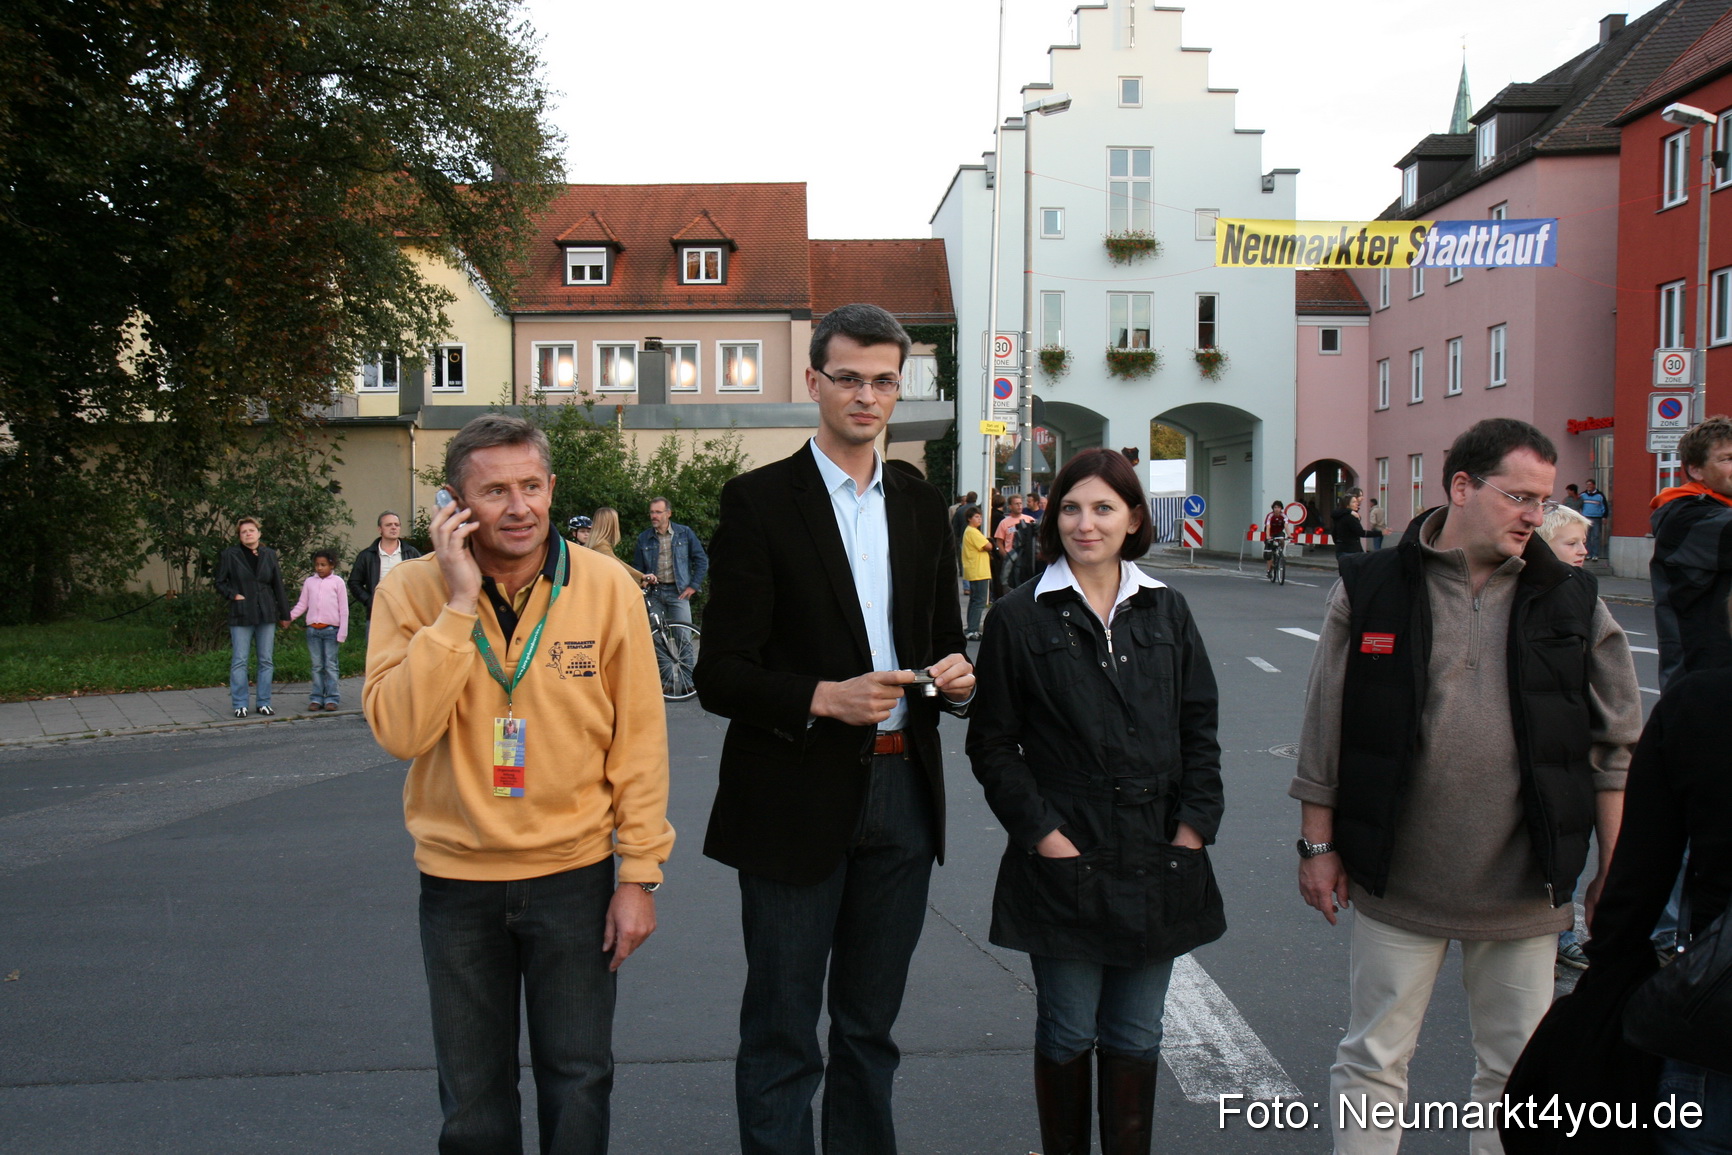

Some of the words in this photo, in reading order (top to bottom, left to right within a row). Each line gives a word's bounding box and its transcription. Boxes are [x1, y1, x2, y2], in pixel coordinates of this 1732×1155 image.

[1221, 223, 1399, 266] Neumarkter
[1406, 223, 1551, 266] Stadtlauf
[995, 341, 1008, 353] 30
[1667, 359, 1681, 370] 30
